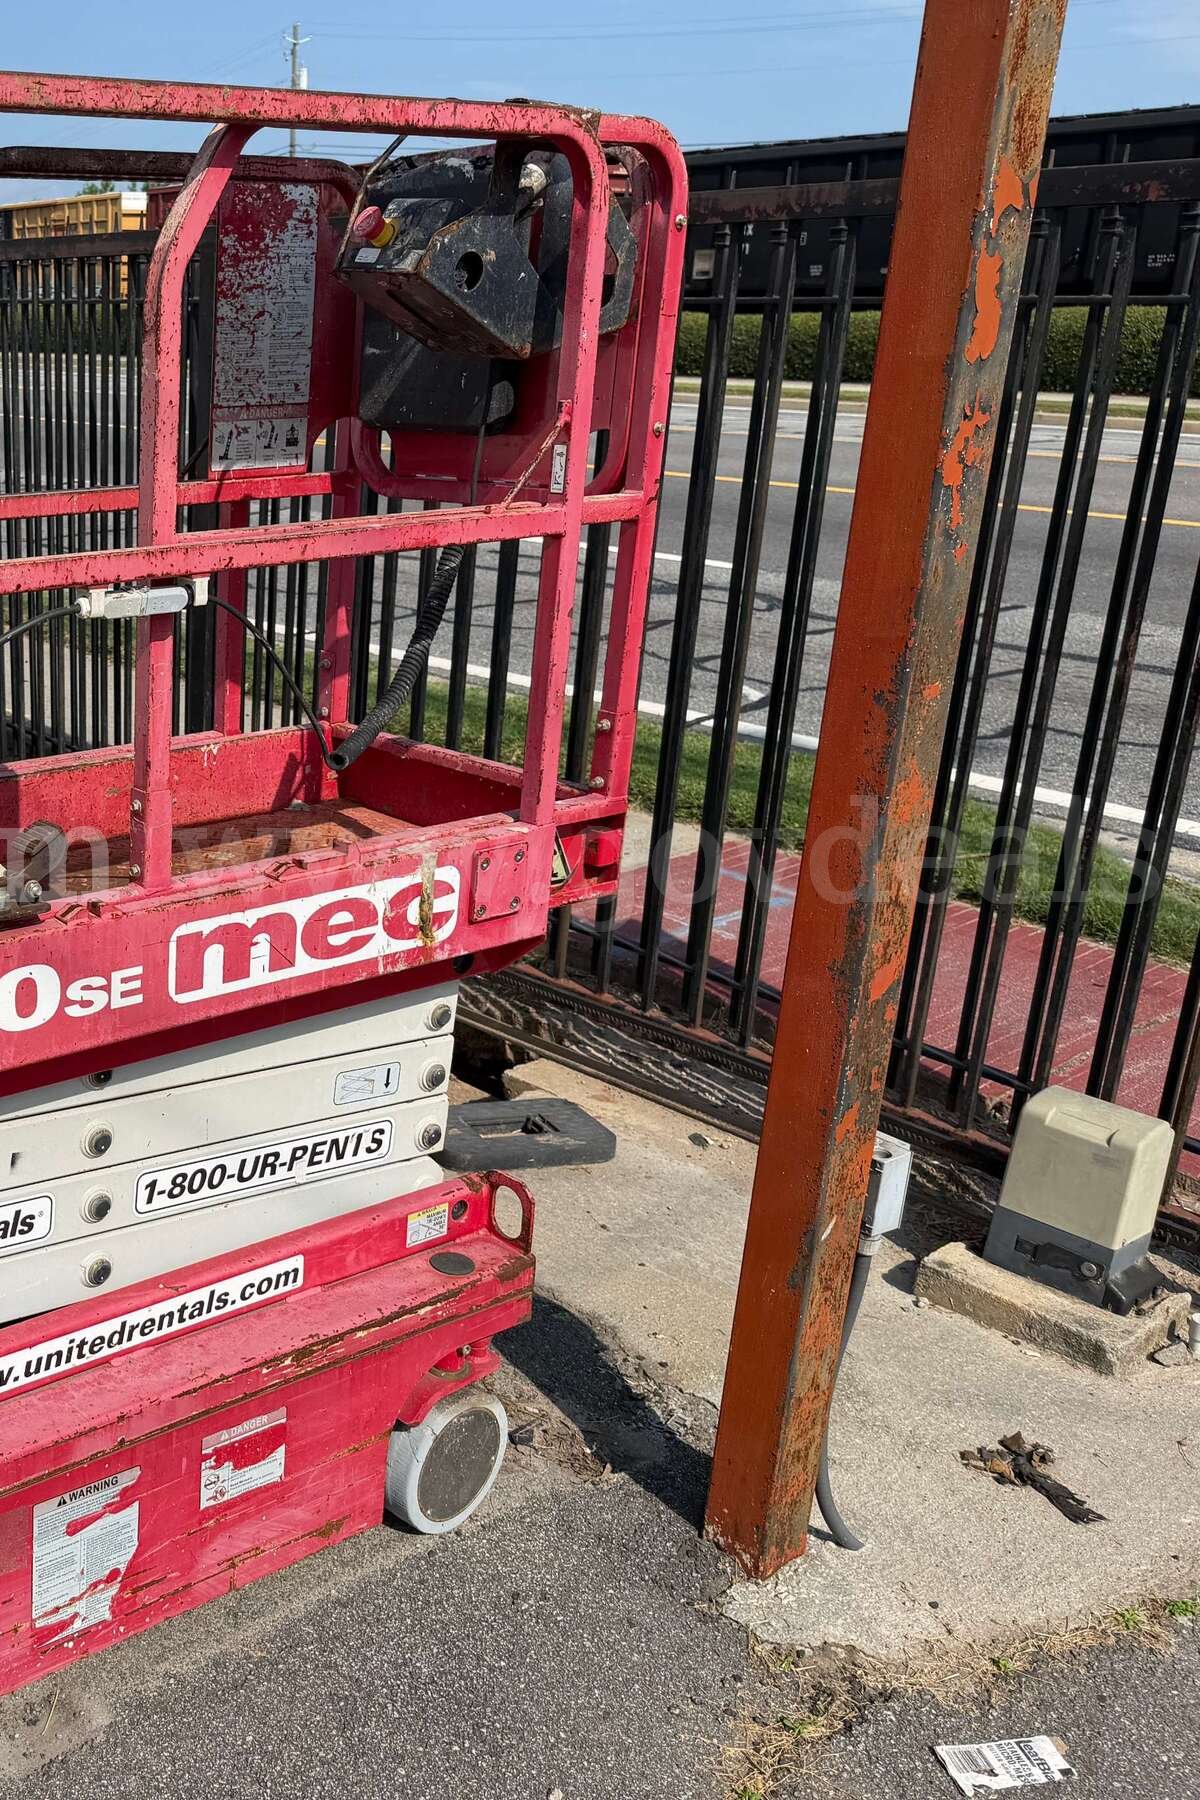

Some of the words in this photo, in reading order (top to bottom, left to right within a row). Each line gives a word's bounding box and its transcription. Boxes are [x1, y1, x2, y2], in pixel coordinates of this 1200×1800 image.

[174, 879, 456, 996] mec
[230, 1414, 269, 1436] DANGER
[68, 1475, 119, 1503] WARNING
